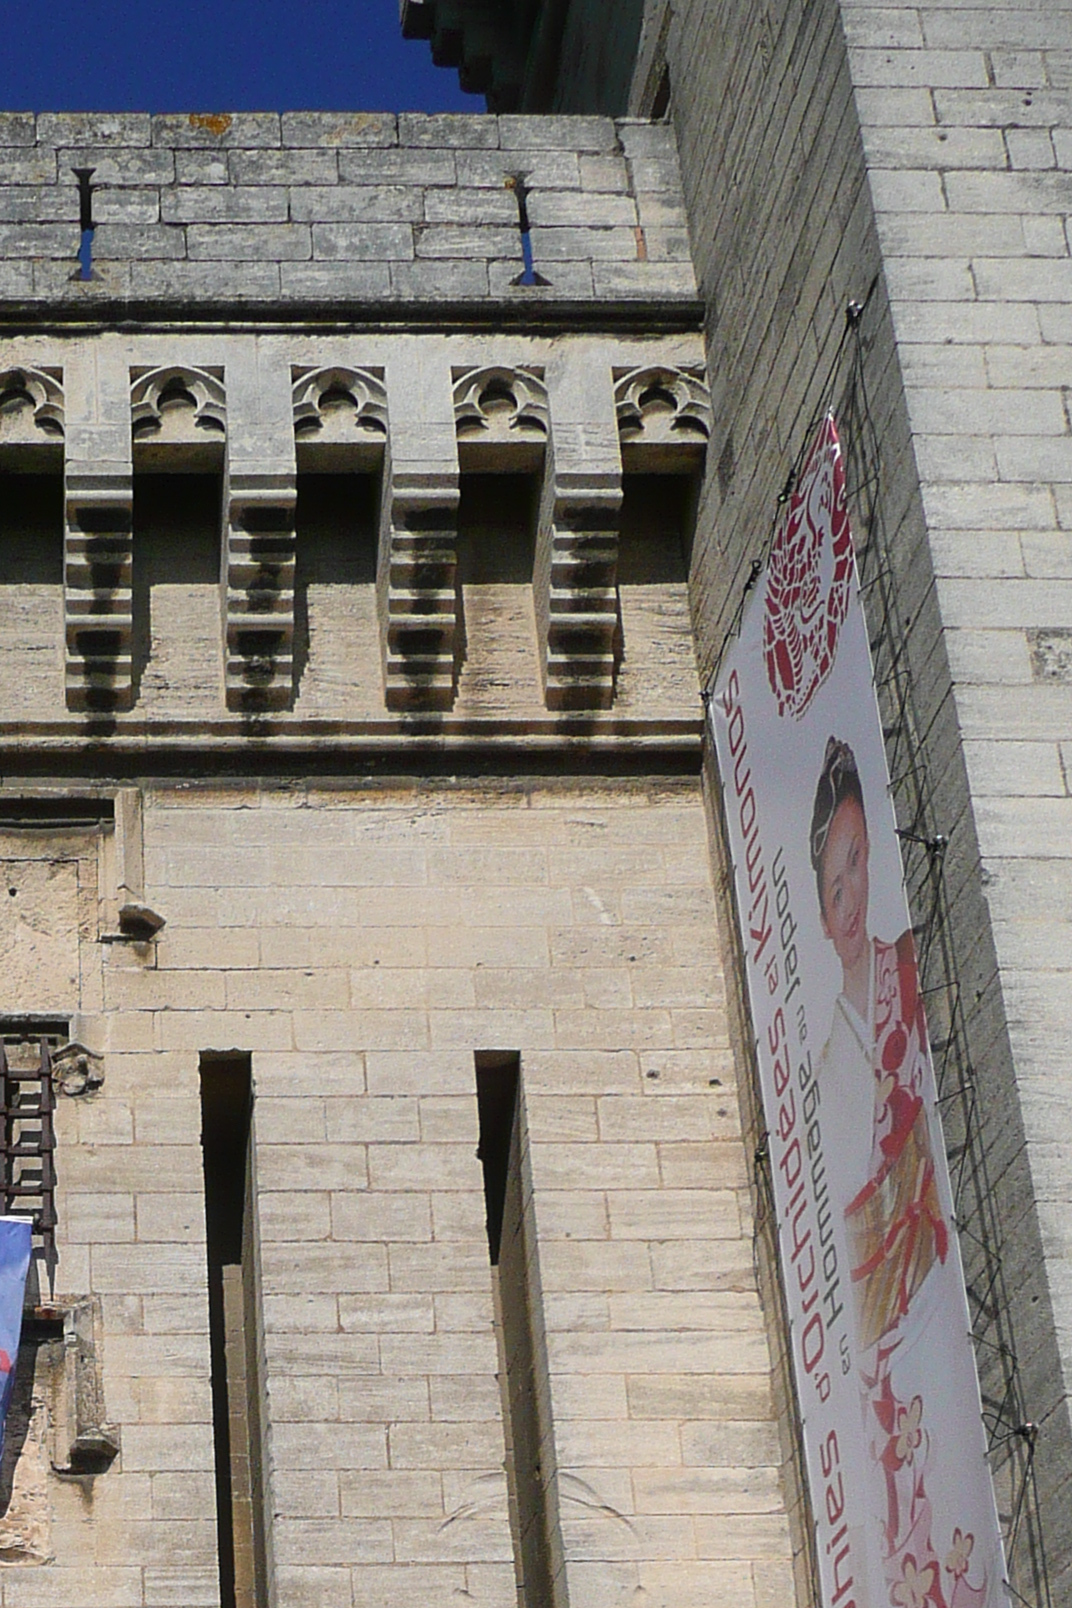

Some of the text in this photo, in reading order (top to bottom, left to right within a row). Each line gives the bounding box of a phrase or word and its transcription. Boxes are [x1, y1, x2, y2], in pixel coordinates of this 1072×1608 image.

[723, 669, 772, 963] Kimonos
[763, 953, 778, 995] et
[768, 1006, 831, 1402] d'Orchidées
[772, 847, 850, 1375] en Hommage au Japon
